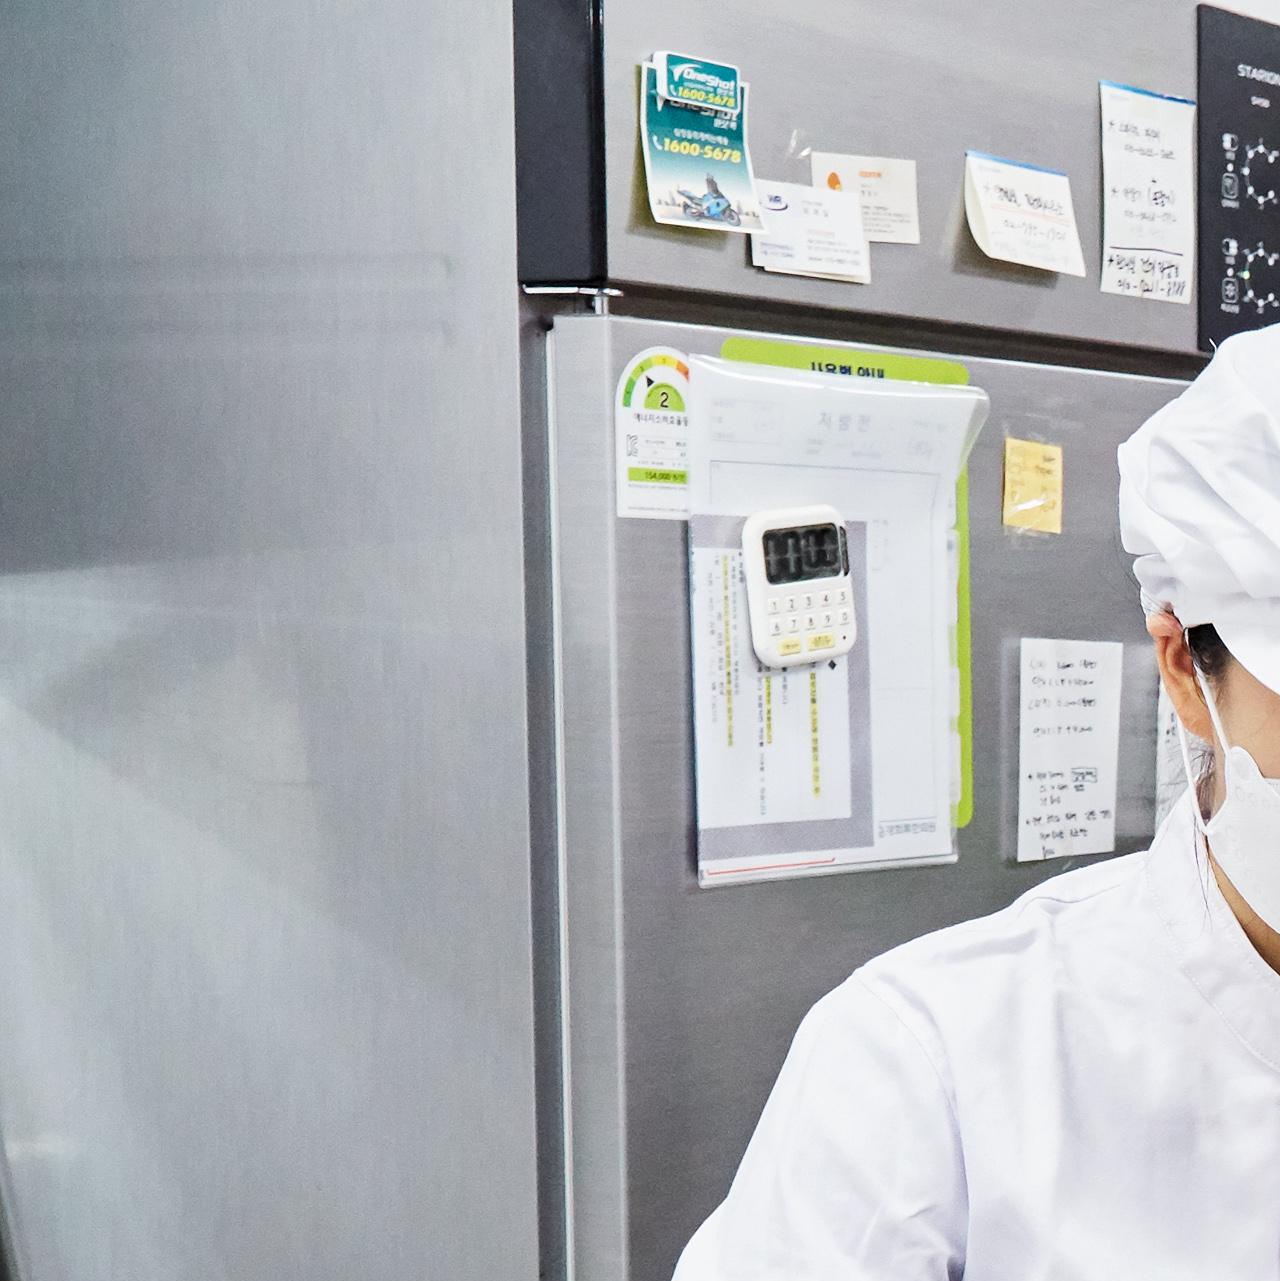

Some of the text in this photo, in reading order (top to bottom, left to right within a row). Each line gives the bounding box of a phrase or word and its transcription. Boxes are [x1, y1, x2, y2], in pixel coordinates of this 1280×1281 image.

[678, 87, 735, 107] 1600-5678
[664, 138, 741, 163] 1600-5678
[660, 392, 669, 408] 2
